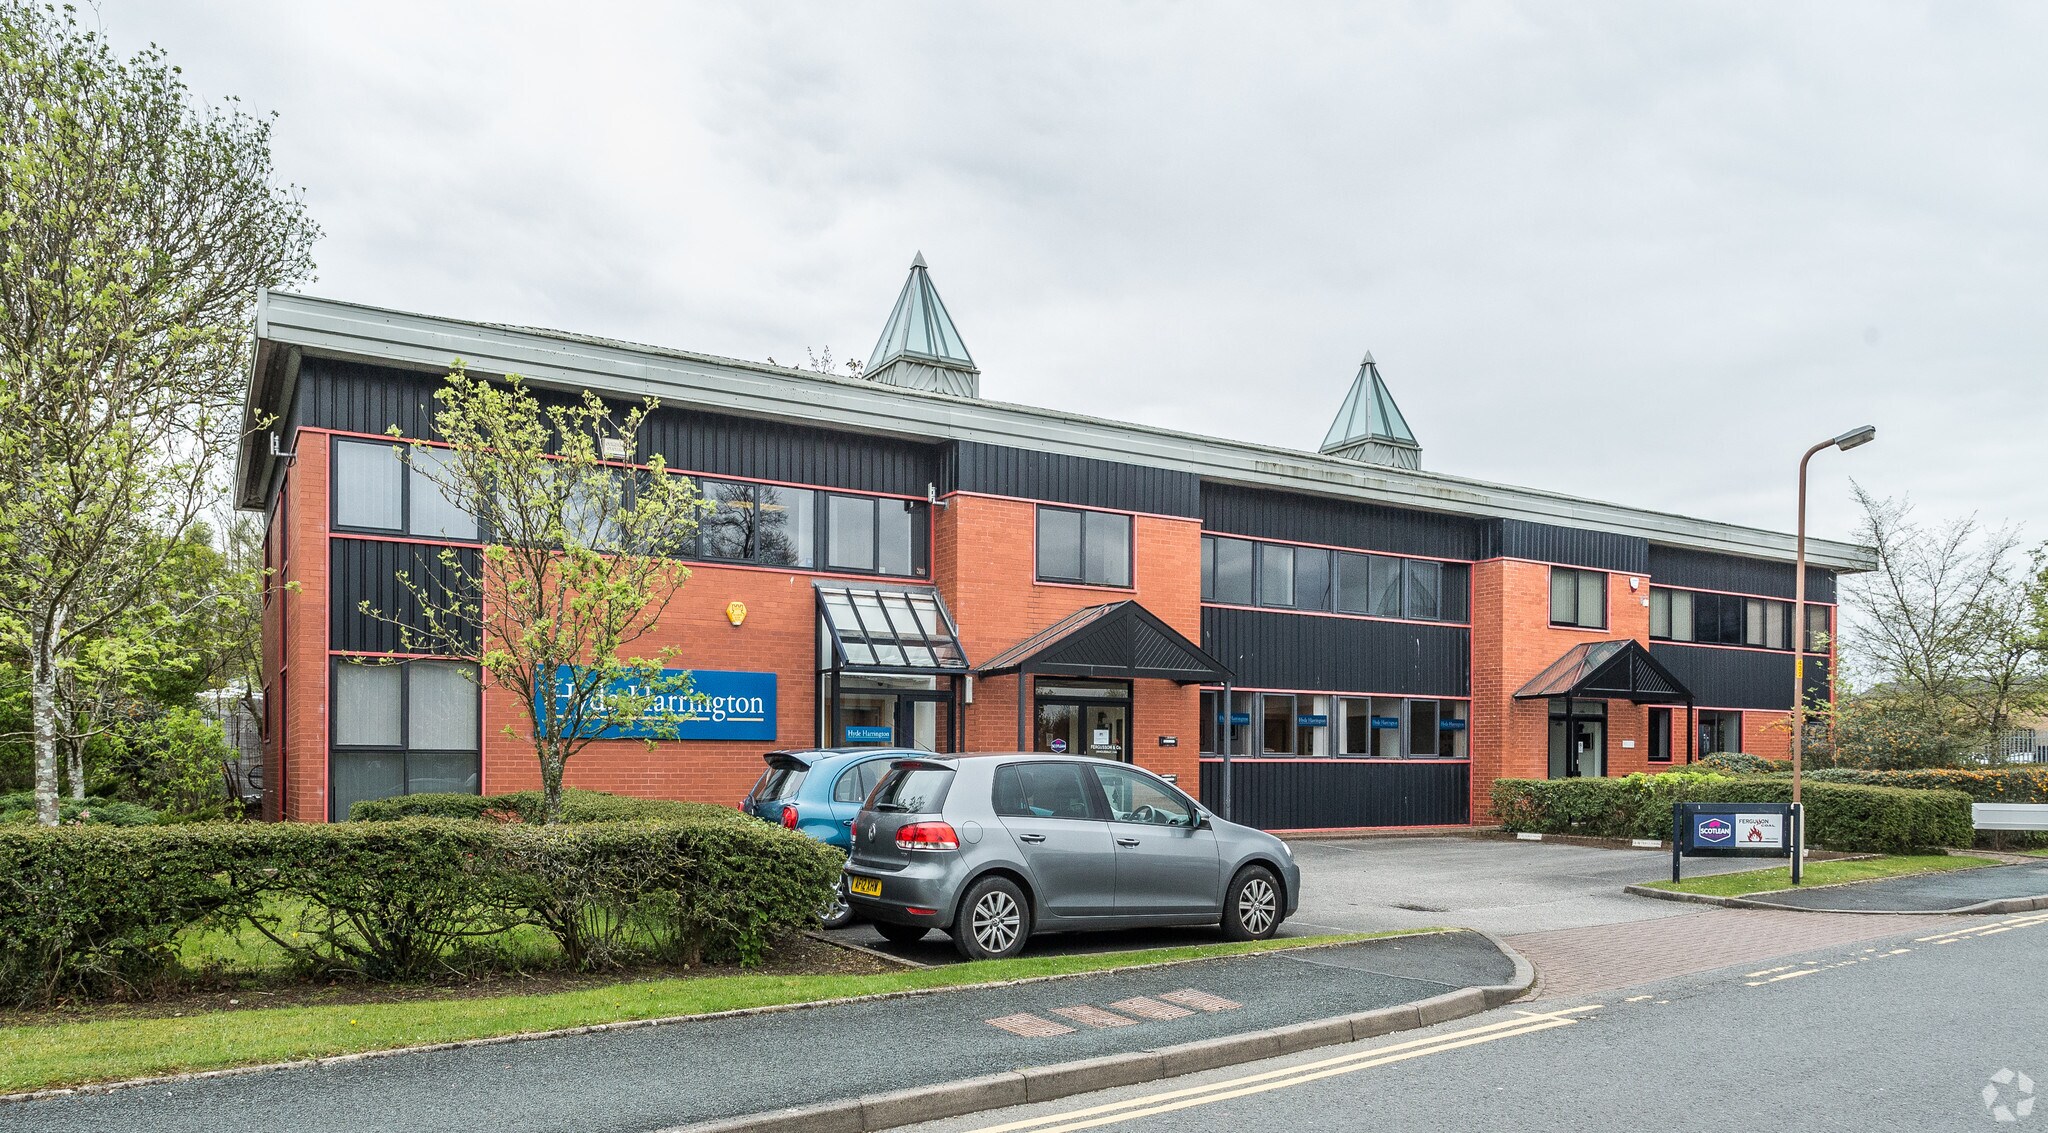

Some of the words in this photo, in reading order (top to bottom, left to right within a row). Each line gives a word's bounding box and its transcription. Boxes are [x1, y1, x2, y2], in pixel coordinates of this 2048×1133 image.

[847, 730, 861, 738] Hyde
[862, 730, 890, 739] Harrington
[1700, 827, 1730, 835] SCOTLEAN
